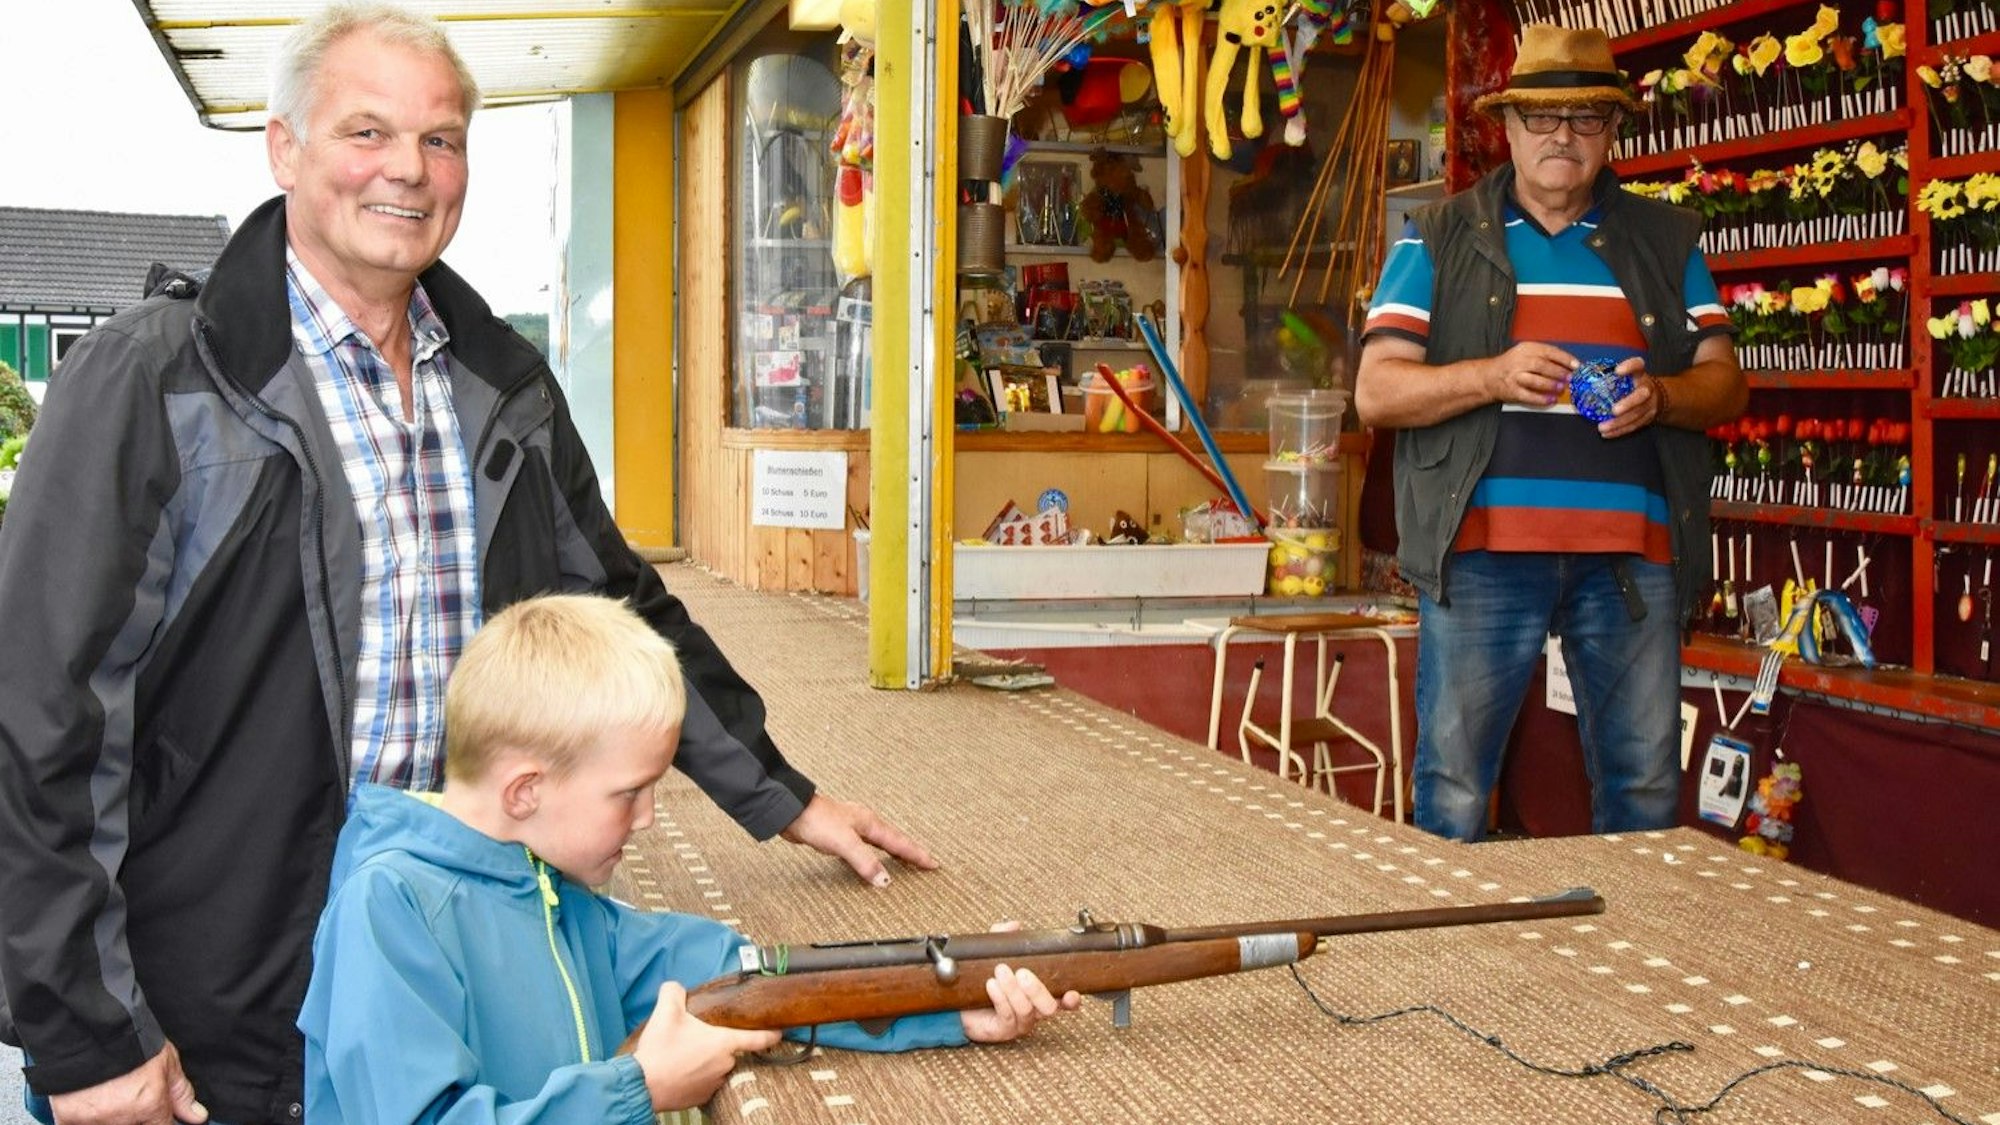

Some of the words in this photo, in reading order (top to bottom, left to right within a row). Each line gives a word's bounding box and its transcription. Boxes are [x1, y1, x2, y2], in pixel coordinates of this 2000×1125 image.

[767, 466, 823, 477] Blumenschießen
[771, 488, 794, 496] Schuss
[803, 489, 809, 498] 5
[810, 489, 828, 498] Euro
[770, 509, 794, 517] Schuss
[800, 510, 809, 518] 10
[810, 510, 828, 519] Euro
